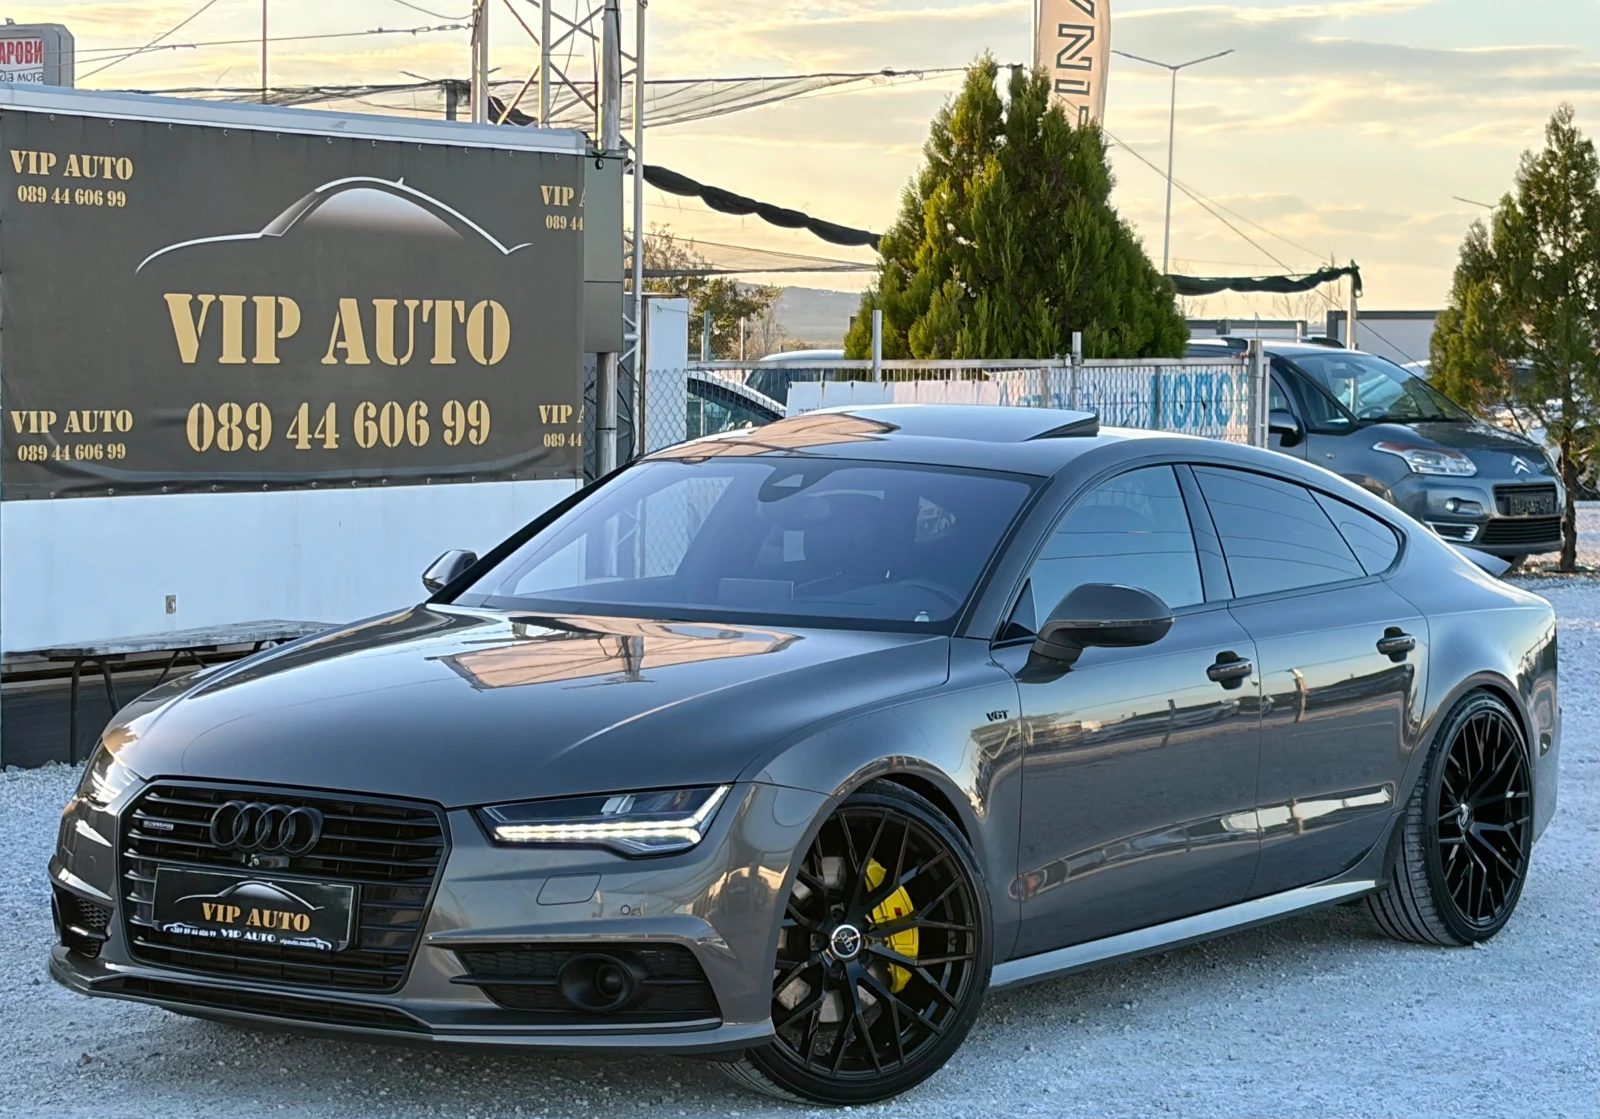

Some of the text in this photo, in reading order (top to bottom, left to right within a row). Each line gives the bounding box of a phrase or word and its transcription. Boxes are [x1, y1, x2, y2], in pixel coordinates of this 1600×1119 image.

[10, 150, 133, 180] VIP AUTO
[18, 185, 126, 207] 089 44 606 99
[541, 185, 575, 206] VIP
[545, 215, 584, 231] 089 44
[164, 293, 511, 366] VIP AUTO
[10, 410, 133, 433] VIP AUTO
[539, 405, 573, 424] VIP
[186, 400, 491, 452] 089 44 606 99
[543, 433, 582, 447] 089 44
[18, 443, 126, 461] 089 44 606 99
[202, 903, 310, 932] VIP AUTO
[221, 928, 241, 939] VIP
[244, 931, 276, 943] AUTO
